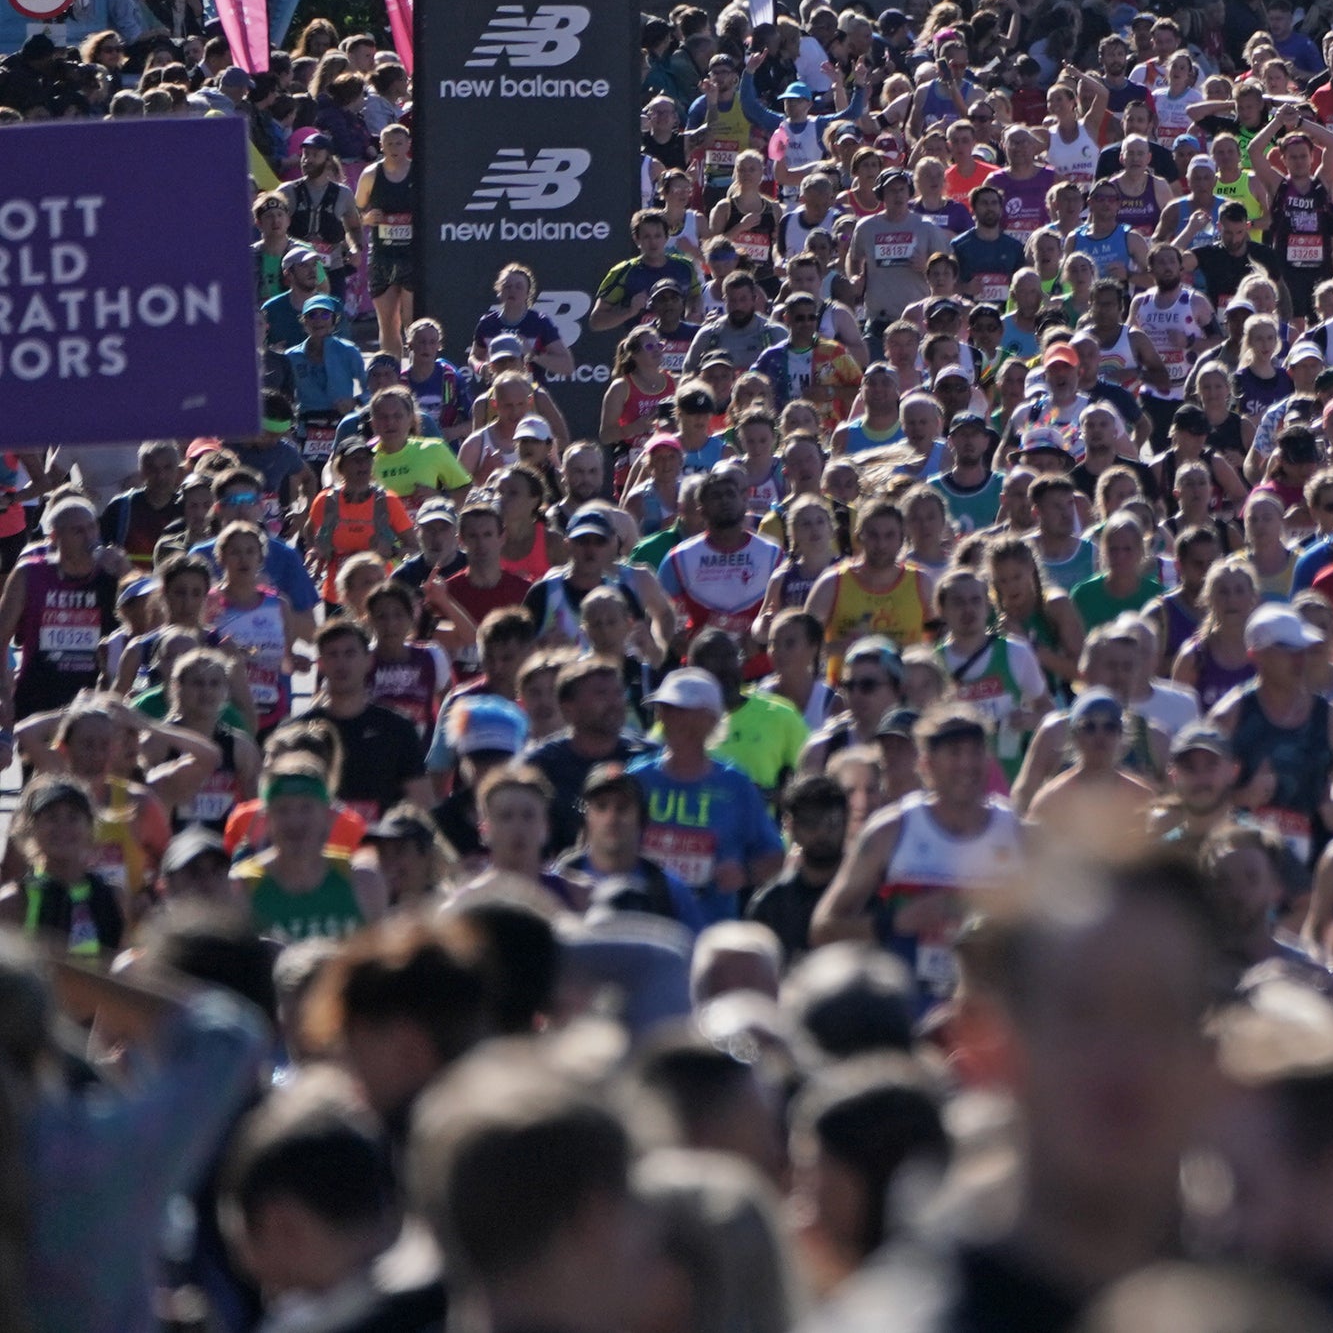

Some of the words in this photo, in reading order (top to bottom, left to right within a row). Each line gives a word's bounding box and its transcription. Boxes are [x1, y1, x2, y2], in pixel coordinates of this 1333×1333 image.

[440, 80, 494, 98] new
[501, 75, 610, 98] balance
[1217, 187, 1236, 195] BEN
[1288, 196, 1314, 210] TEDDY
[440, 223, 494, 241] new
[501, 217, 610, 241] balance
[1146, 313, 1180, 324] STEVE
[0, 335, 128, 381] ORS
[699, 553, 752, 567] NABEEL
[46, 590, 97, 608] KEITH
[650, 789, 712, 827] ULI
